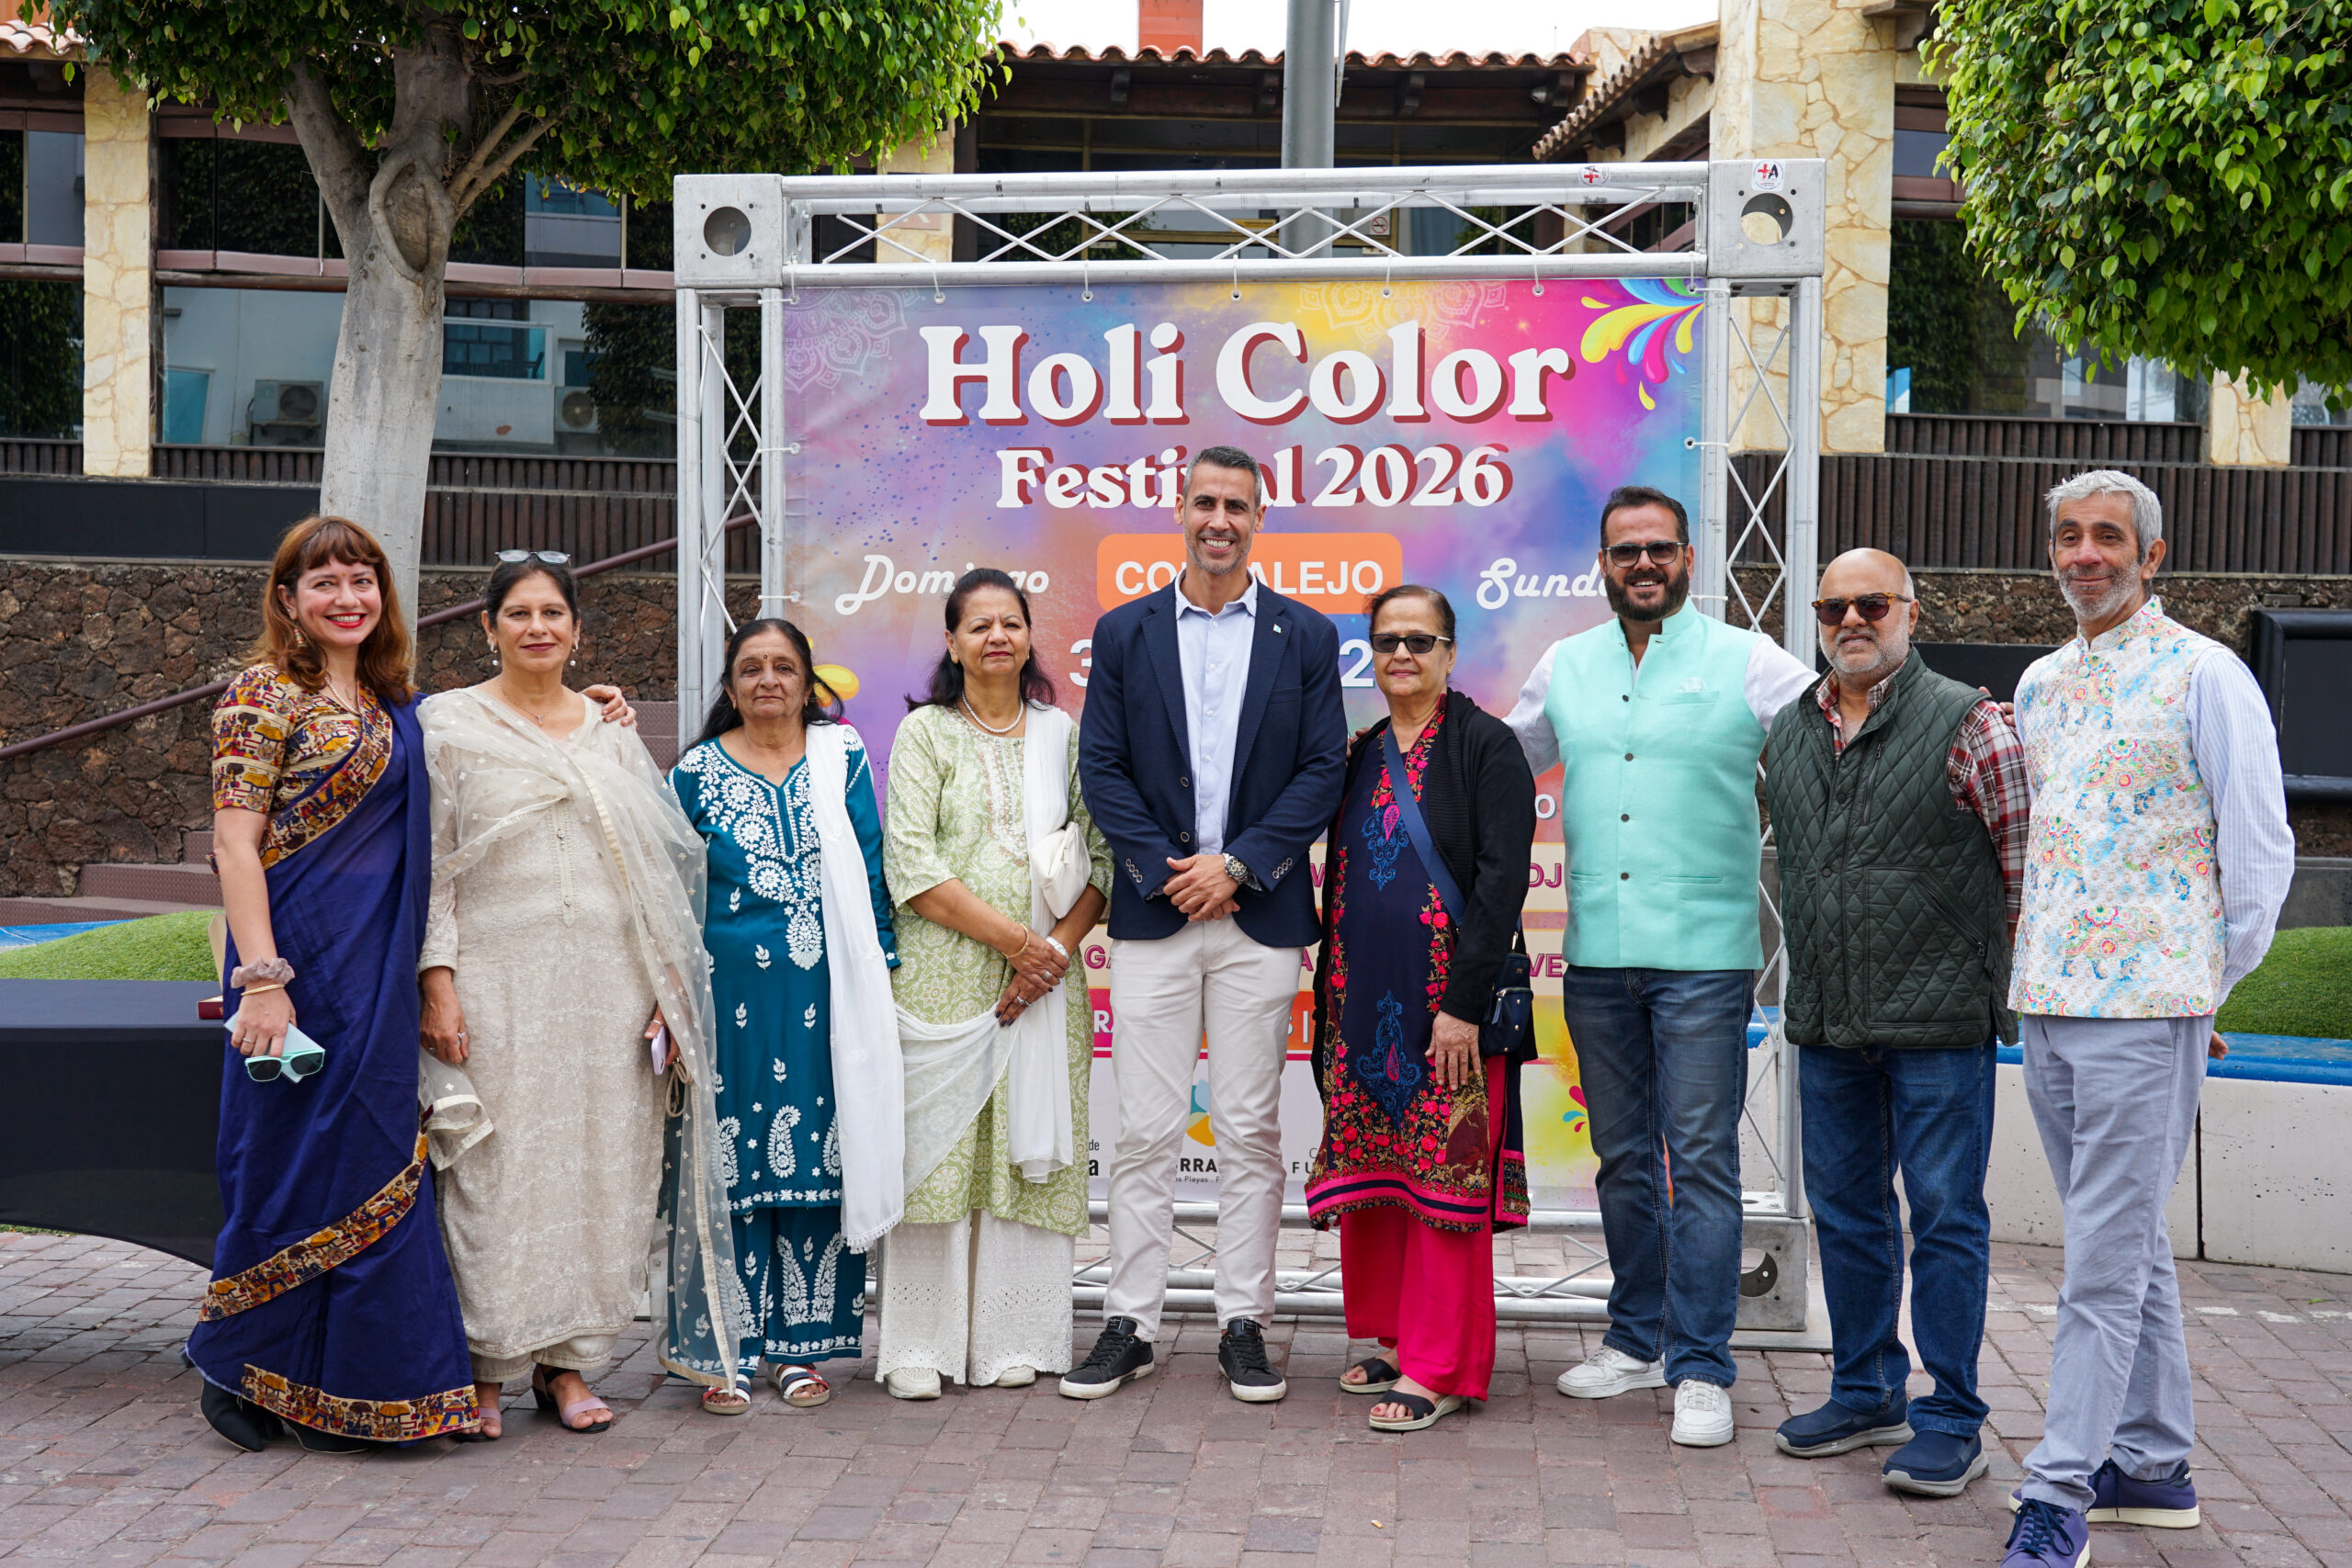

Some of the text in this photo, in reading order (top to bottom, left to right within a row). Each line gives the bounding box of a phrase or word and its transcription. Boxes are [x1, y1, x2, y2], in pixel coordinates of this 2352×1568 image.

[919, 320, 1575, 426] Holi Color
[996, 444, 1513, 508] Festil 2026
[835, 555, 1050, 615] Domo
[1115, 560, 1384, 595] COALEJO
